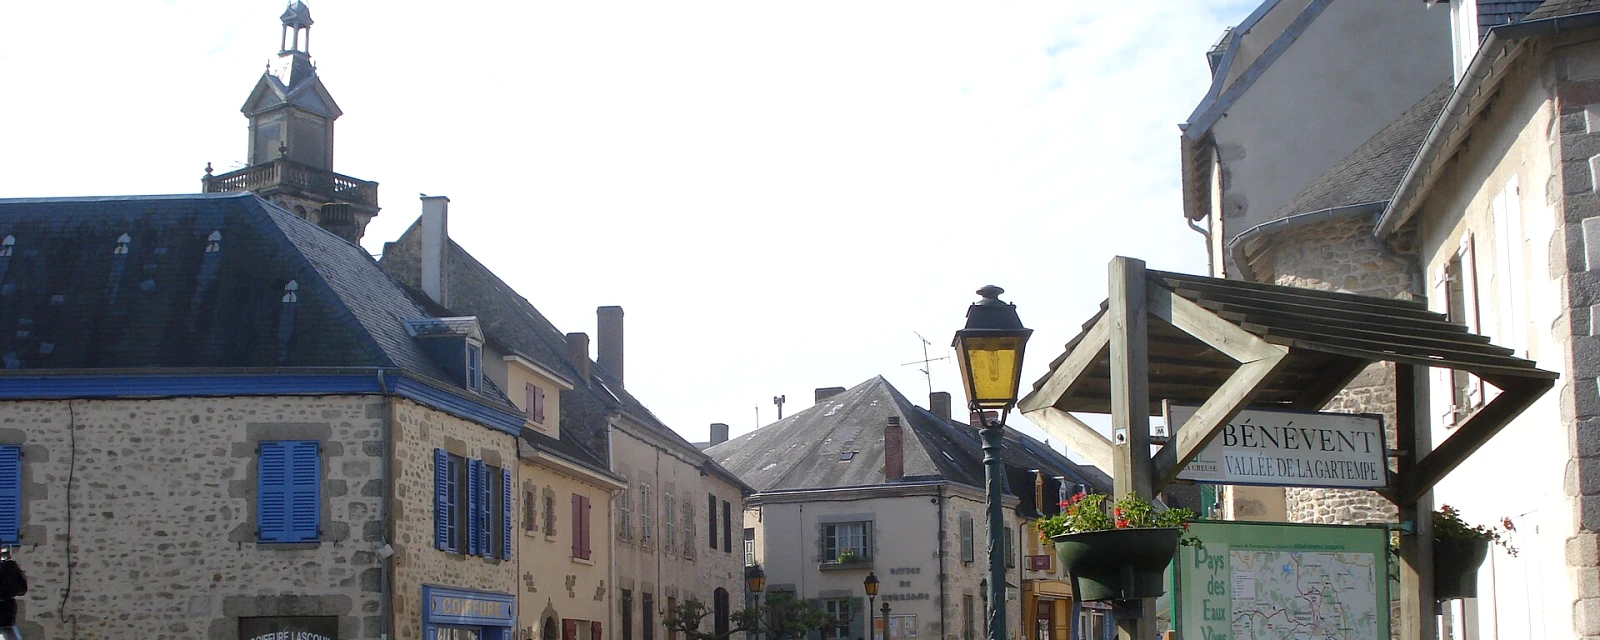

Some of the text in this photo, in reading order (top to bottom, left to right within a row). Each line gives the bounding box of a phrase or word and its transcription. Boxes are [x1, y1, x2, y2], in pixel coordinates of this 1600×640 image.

[1223, 418, 1375, 453] BÉNÉVENT
[1192, 464, 1218, 472] CREUSE
[1225, 452, 1378, 481] VALLÉE DE LA GARTEMPE
[1195, 545, 1224, 575] Pays
[1208, 575, 1225, 596] des
[443, 598, 502, 617] COIFFURE
[1203, 599, 1226, 621] Eaux
[250, 632, 331, 640] IFFURE LASCO
